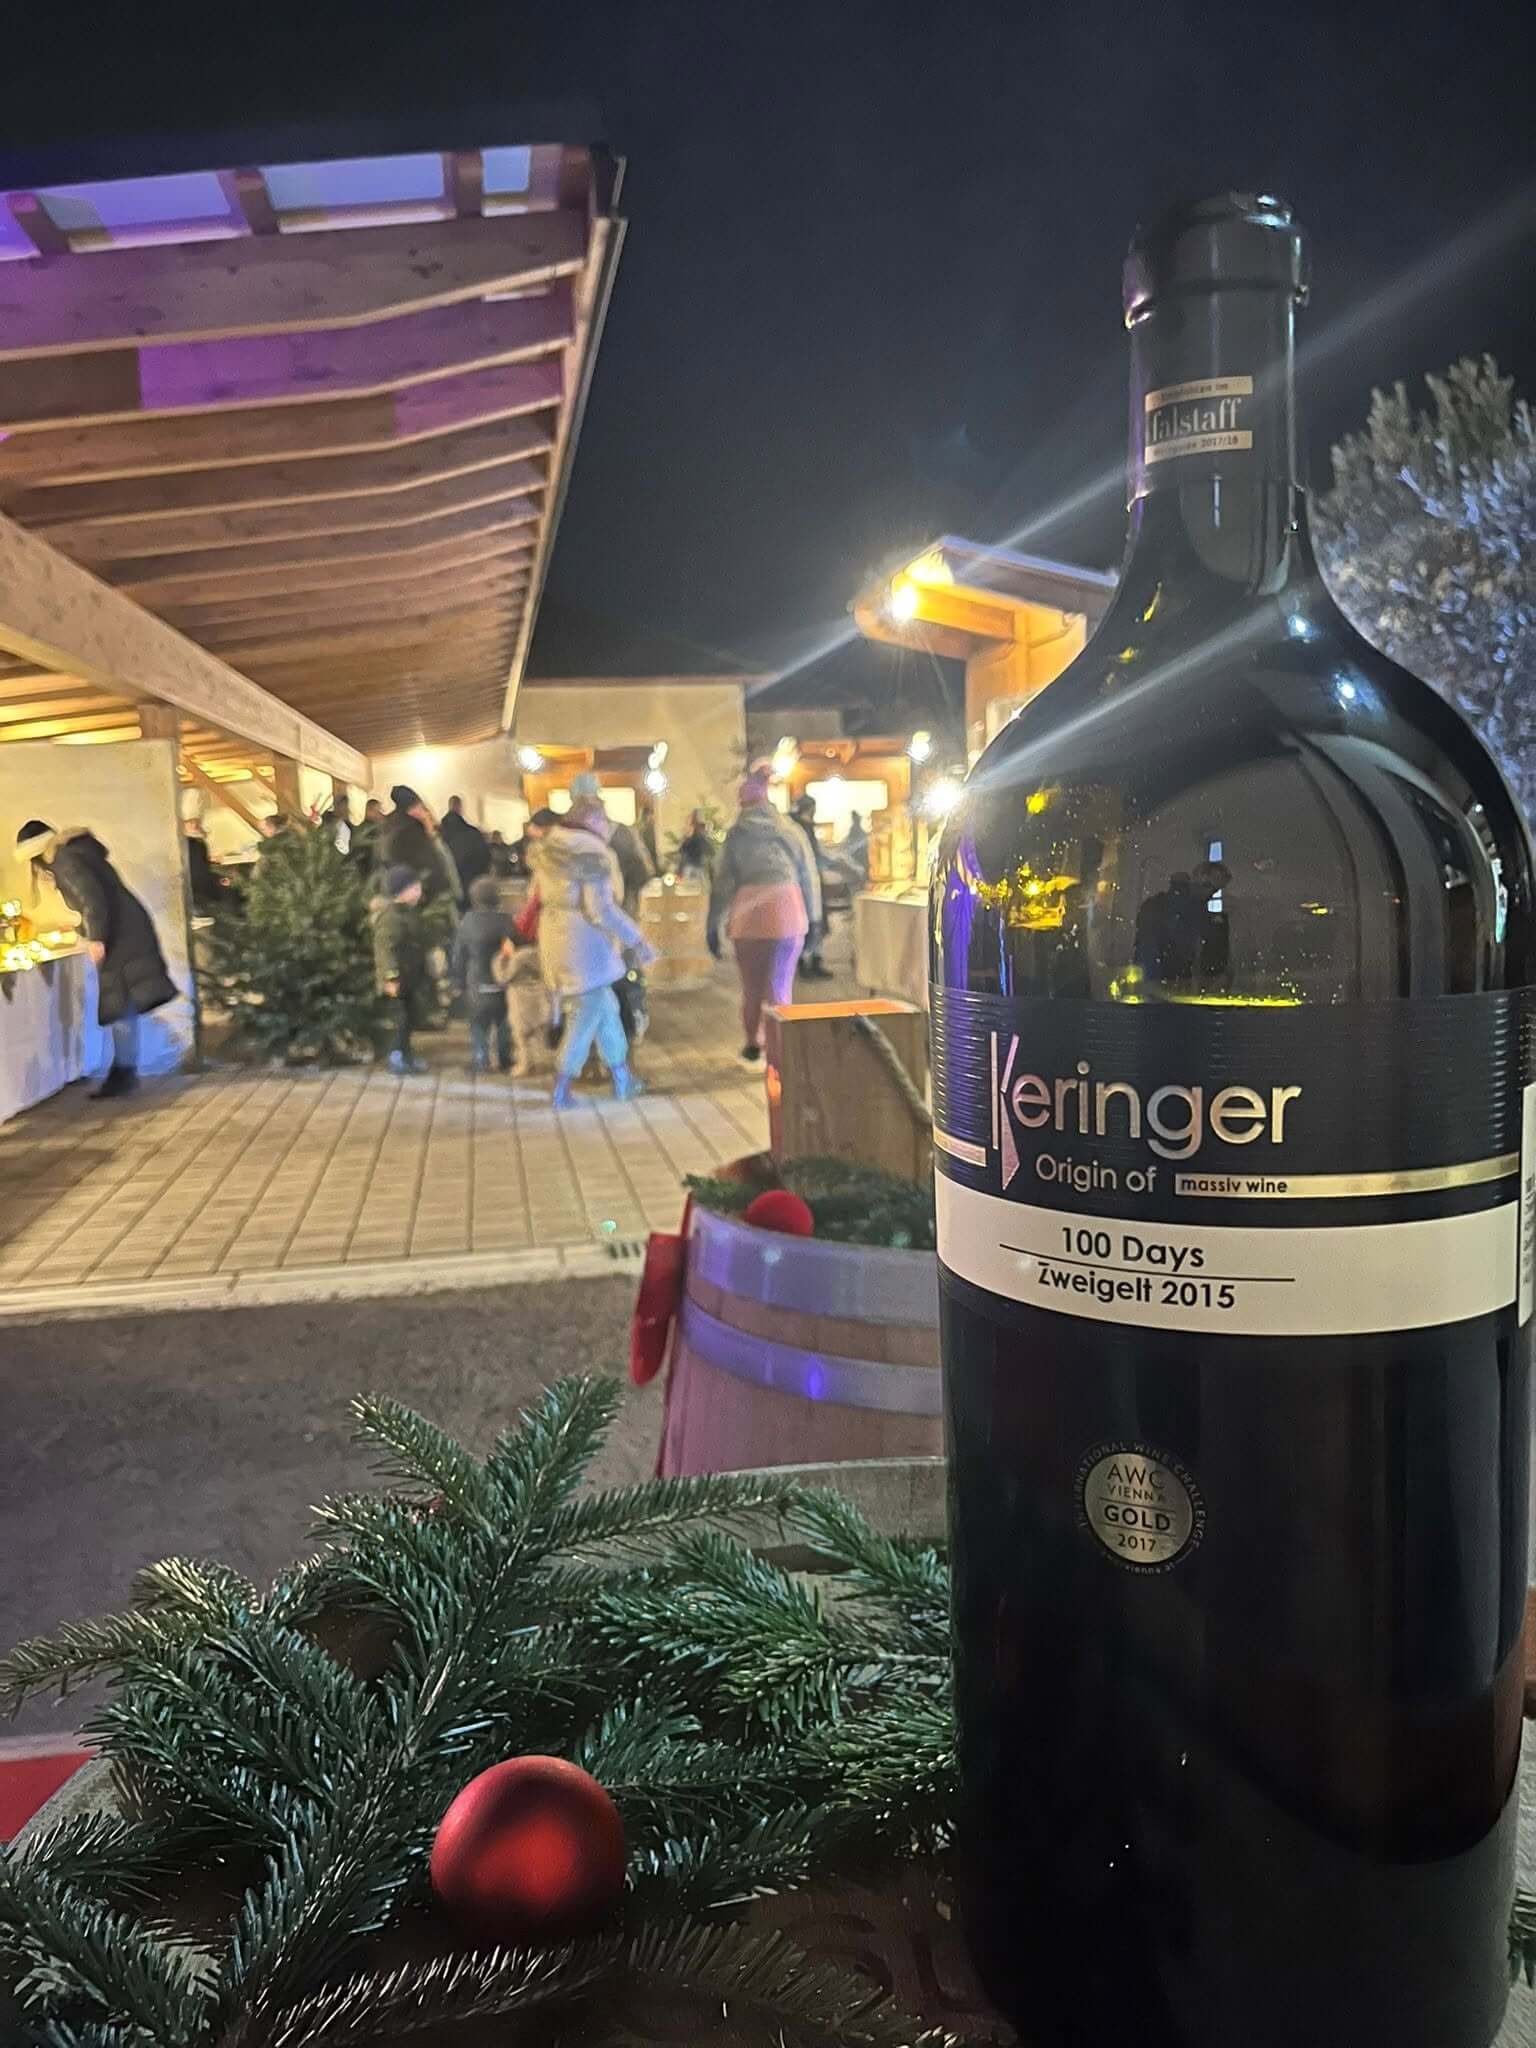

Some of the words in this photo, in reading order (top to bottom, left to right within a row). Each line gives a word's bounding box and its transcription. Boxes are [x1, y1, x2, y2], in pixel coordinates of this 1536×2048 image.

[1152, 397, 1242, 442] falstaff
[991, 1031, 1302, 1190] Keringer
[1036, 1153, 1117, 1192] Origin
[1126, 1166, 1157, 1193] of
[1181, 1177, 1241, 1193] massiv
[1246, 1177, 1288, 1193] wine
[1062, 1227, 1111, 1259] 100
[1122, 1235, 1204, 1272] Days
[1037, 1261, 1152, 1303] Zweigelt
[1161, 1280, 1235, 1309] 2015
[1107, 1463, 1165, 1489] AWC
[1104, 1504, 1170, 1531] GOLD
[1118, 1533, 1157, 1552] 2017
